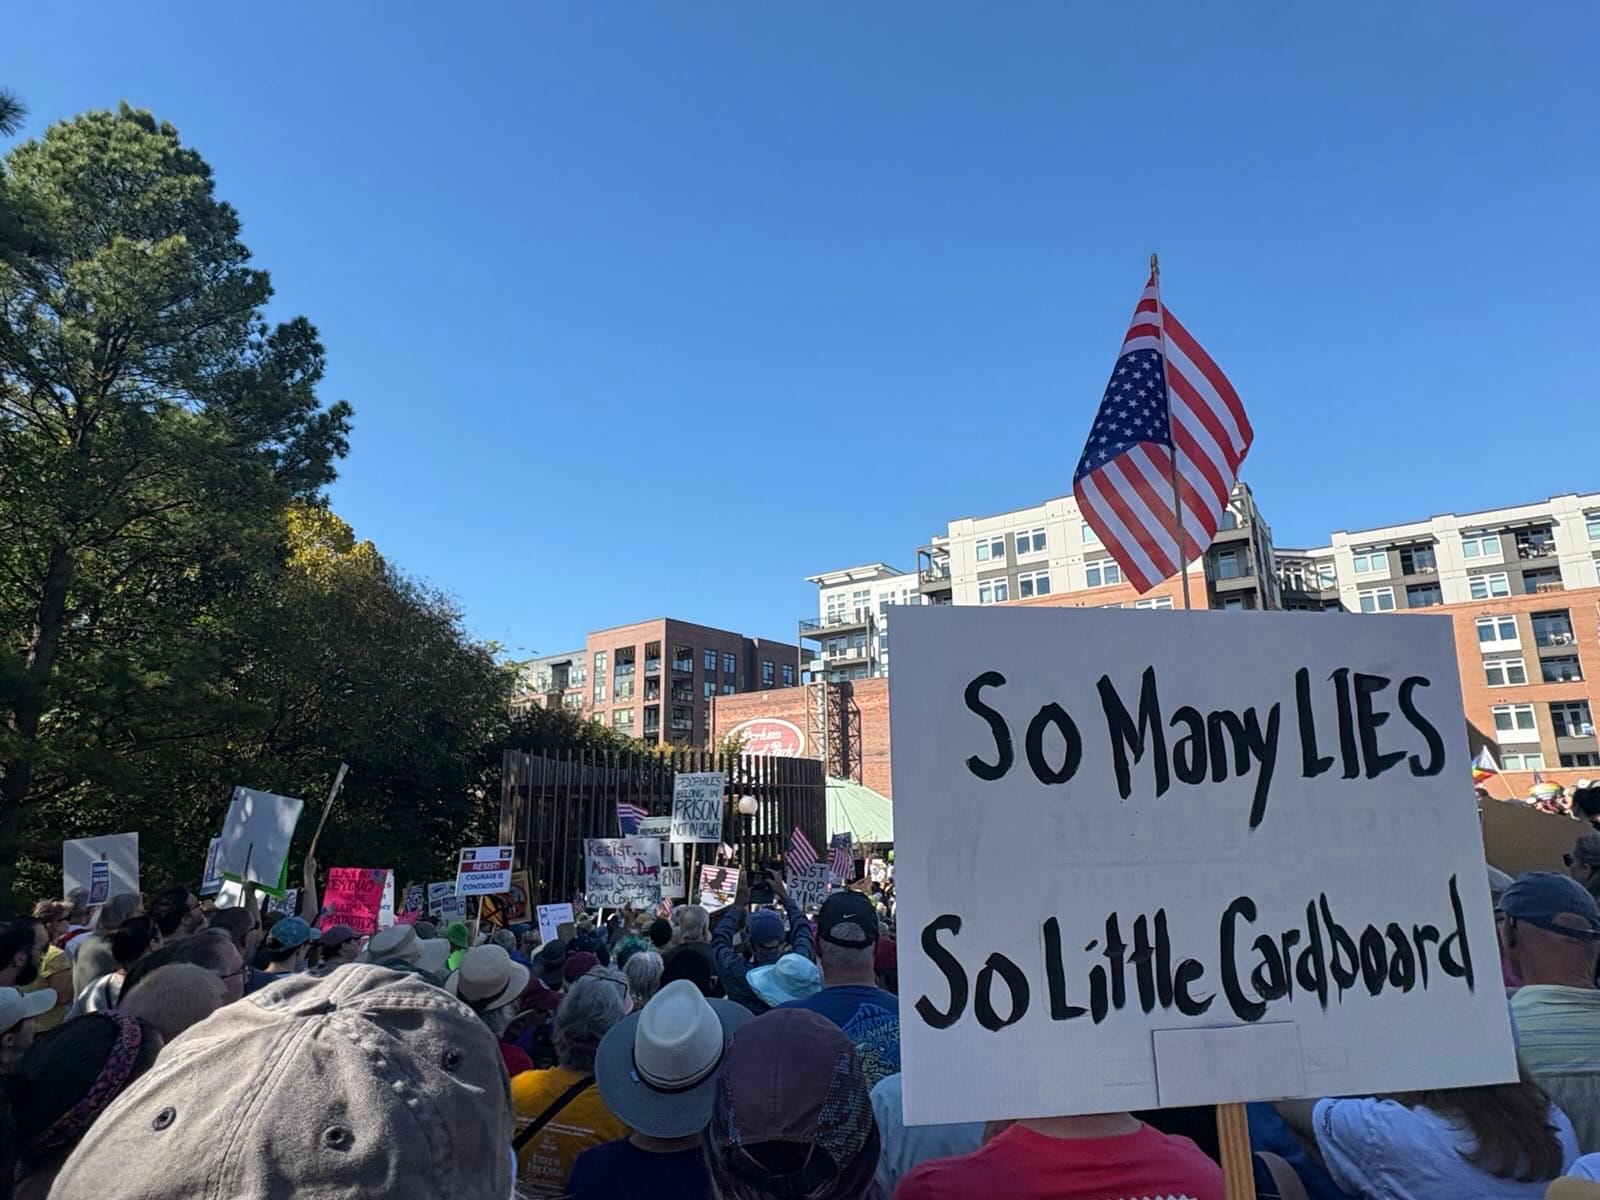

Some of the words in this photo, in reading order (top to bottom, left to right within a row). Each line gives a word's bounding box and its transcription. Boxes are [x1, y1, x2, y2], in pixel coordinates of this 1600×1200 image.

[964, 670, 1083, 786] So
[1096, 665, 1281, 829] Many
[1295, 666, 1446, 780] LIES
[676, 789, 705, 799] BELONG
[709, 789, 719, 798] IN
[672, 822, 688, 836] NOT
[689, 823, 698, 836] IN
[462, 882, 504, 891] CONTAGIOUS
[790, 878, 825, 893] STOP
[914, 914, 1030, 1033] So
[1042, 908, 1217, 1025] Little
[1219, 874, 1474, 1023] Cardboard
